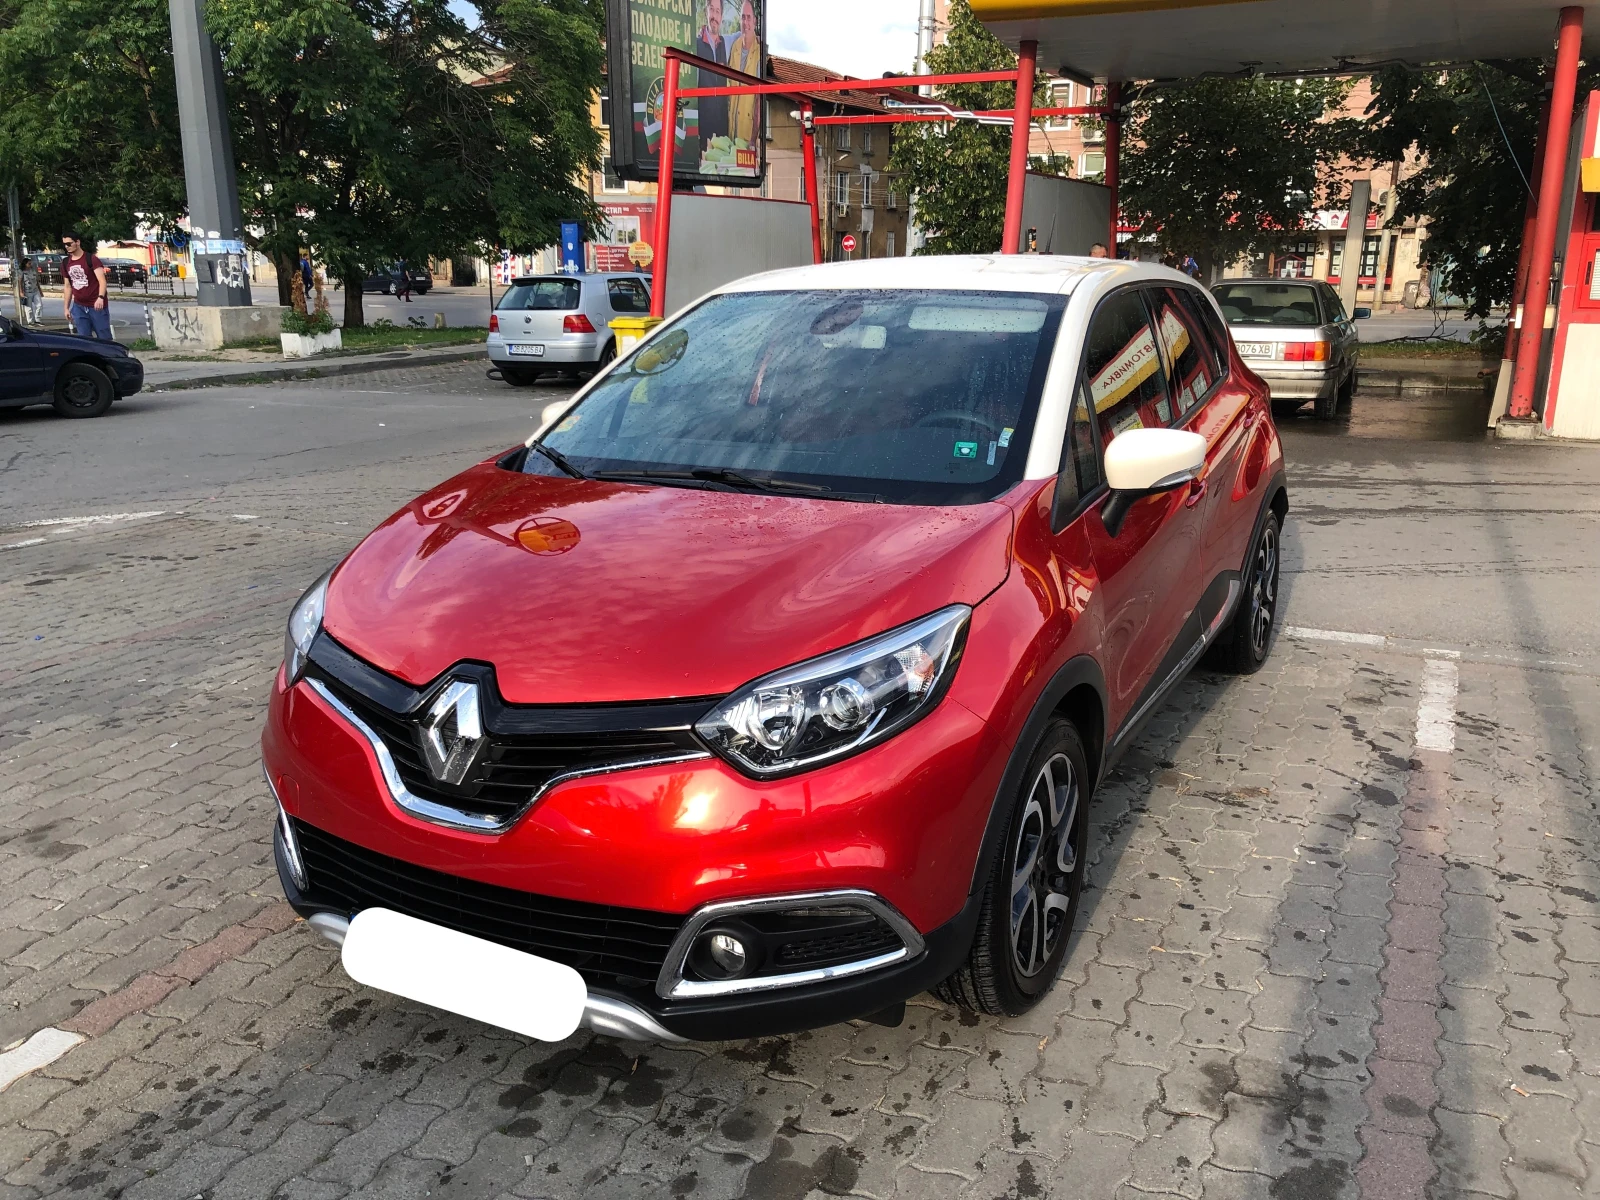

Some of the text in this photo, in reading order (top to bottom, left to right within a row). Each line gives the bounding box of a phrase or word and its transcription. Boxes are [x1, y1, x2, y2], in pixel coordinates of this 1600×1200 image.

[631, 10, 691, 45] ПЛОДОВЕ И
[631, 41, 692, 77] ЗЕЛЕНЦИ
[737, 152, 755, 165] BILLA
[1258, 345, 1270, 353] XB
